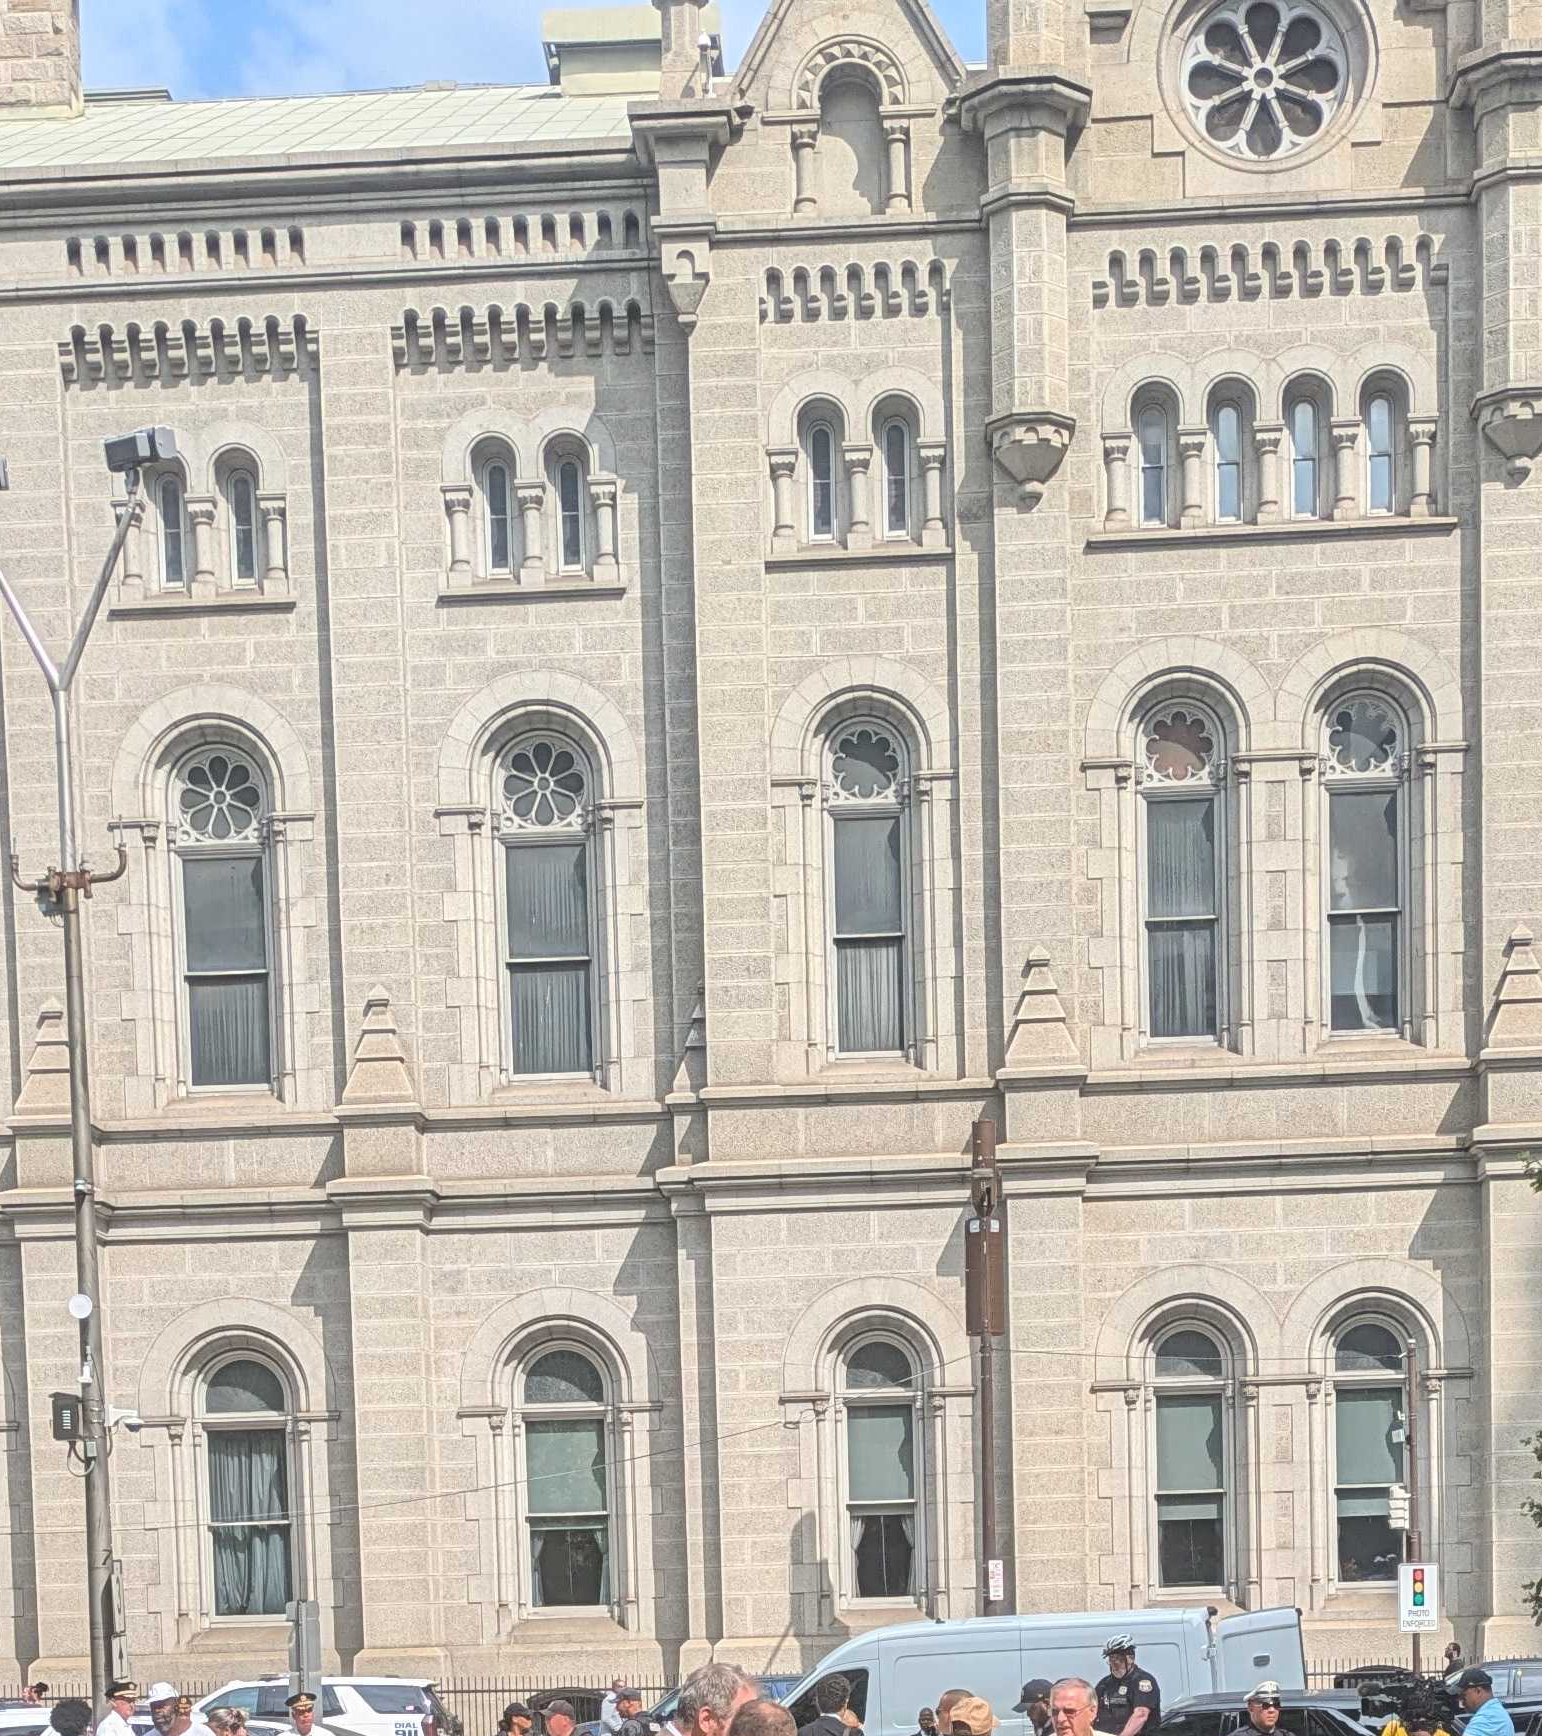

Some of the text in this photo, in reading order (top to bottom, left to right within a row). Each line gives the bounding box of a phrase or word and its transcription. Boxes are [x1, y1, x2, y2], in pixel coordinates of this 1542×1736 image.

[101, 1548, 112, 1566] 7
[1407, 1609, 1430, 1617] PHOTO
[1402, 1620, 1436, 1628] ENFORCED
